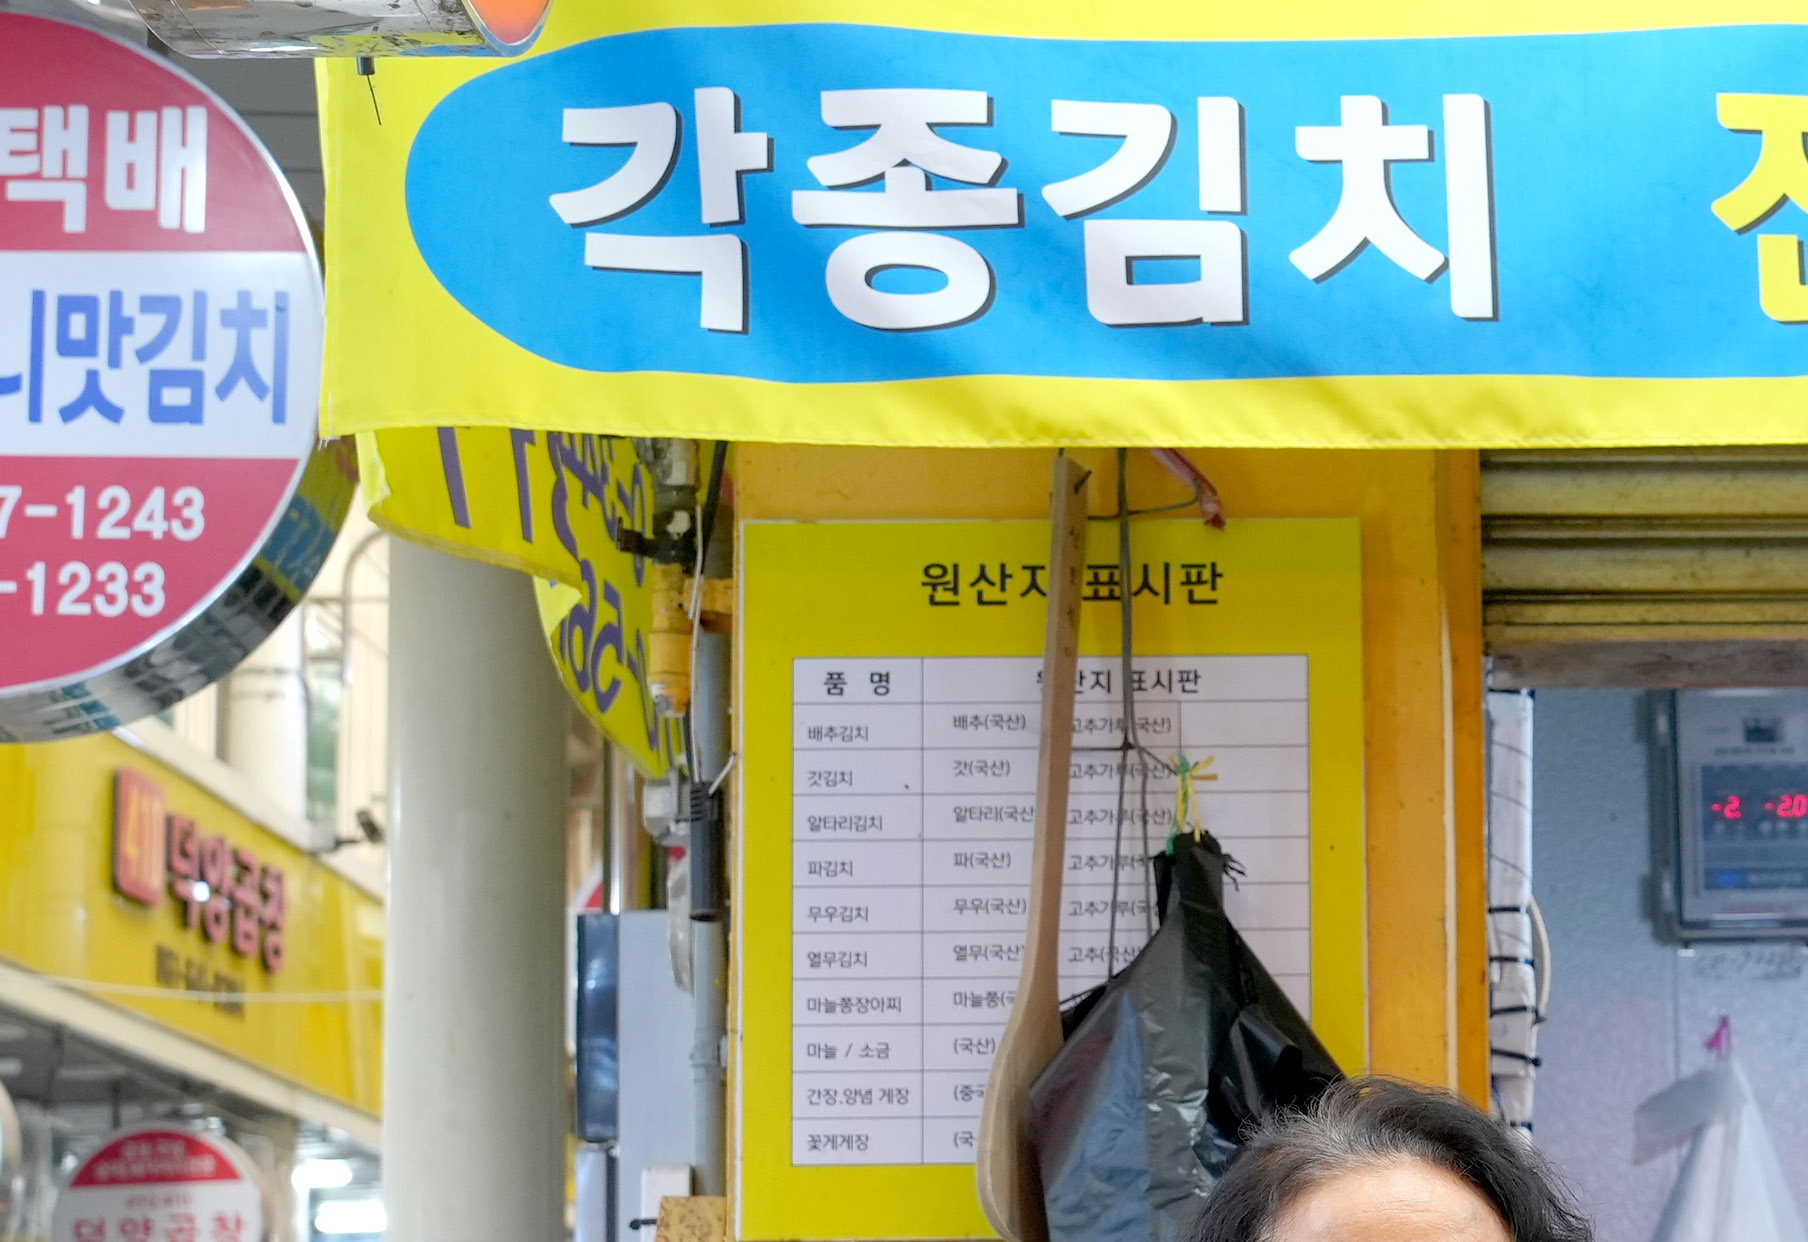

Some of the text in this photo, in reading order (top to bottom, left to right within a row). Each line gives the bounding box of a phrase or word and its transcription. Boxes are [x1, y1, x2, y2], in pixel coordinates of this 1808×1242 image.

[1, 104, 207, 233] 택배
[549, 86, 1498, 333] 각종김치
[1082, 561, 1224, 605] 표시판
[953, 714, 1027, 731] 배추(국산)
[807, 726, 869, 742] 배추김치
[953, 759, 1012, 777] 갓(국산)
[807, 770, 853, 787] 갓김치
[953, 806, 1035, 823] 알타리(국산
[807, 815, 883, 832] 알타리김치
[807, 861, 854, 877] 파김치
[953, 852, 1012, 869] 파(국산)
[807, 905, 869, 923] 무우김치
[953, 898, 1028, 915] 무우(국산)
[807, 952, 868, 968] 열무김치
[807, 1042, 838, 1059] 마늘
[859, 1042, 891, 1060] 소금
[953, 1037, 996, 1055] (국산)
[879, 1087, 909, 1105] 게장
[807, 1134, 869, 1151] 꽃게게장
